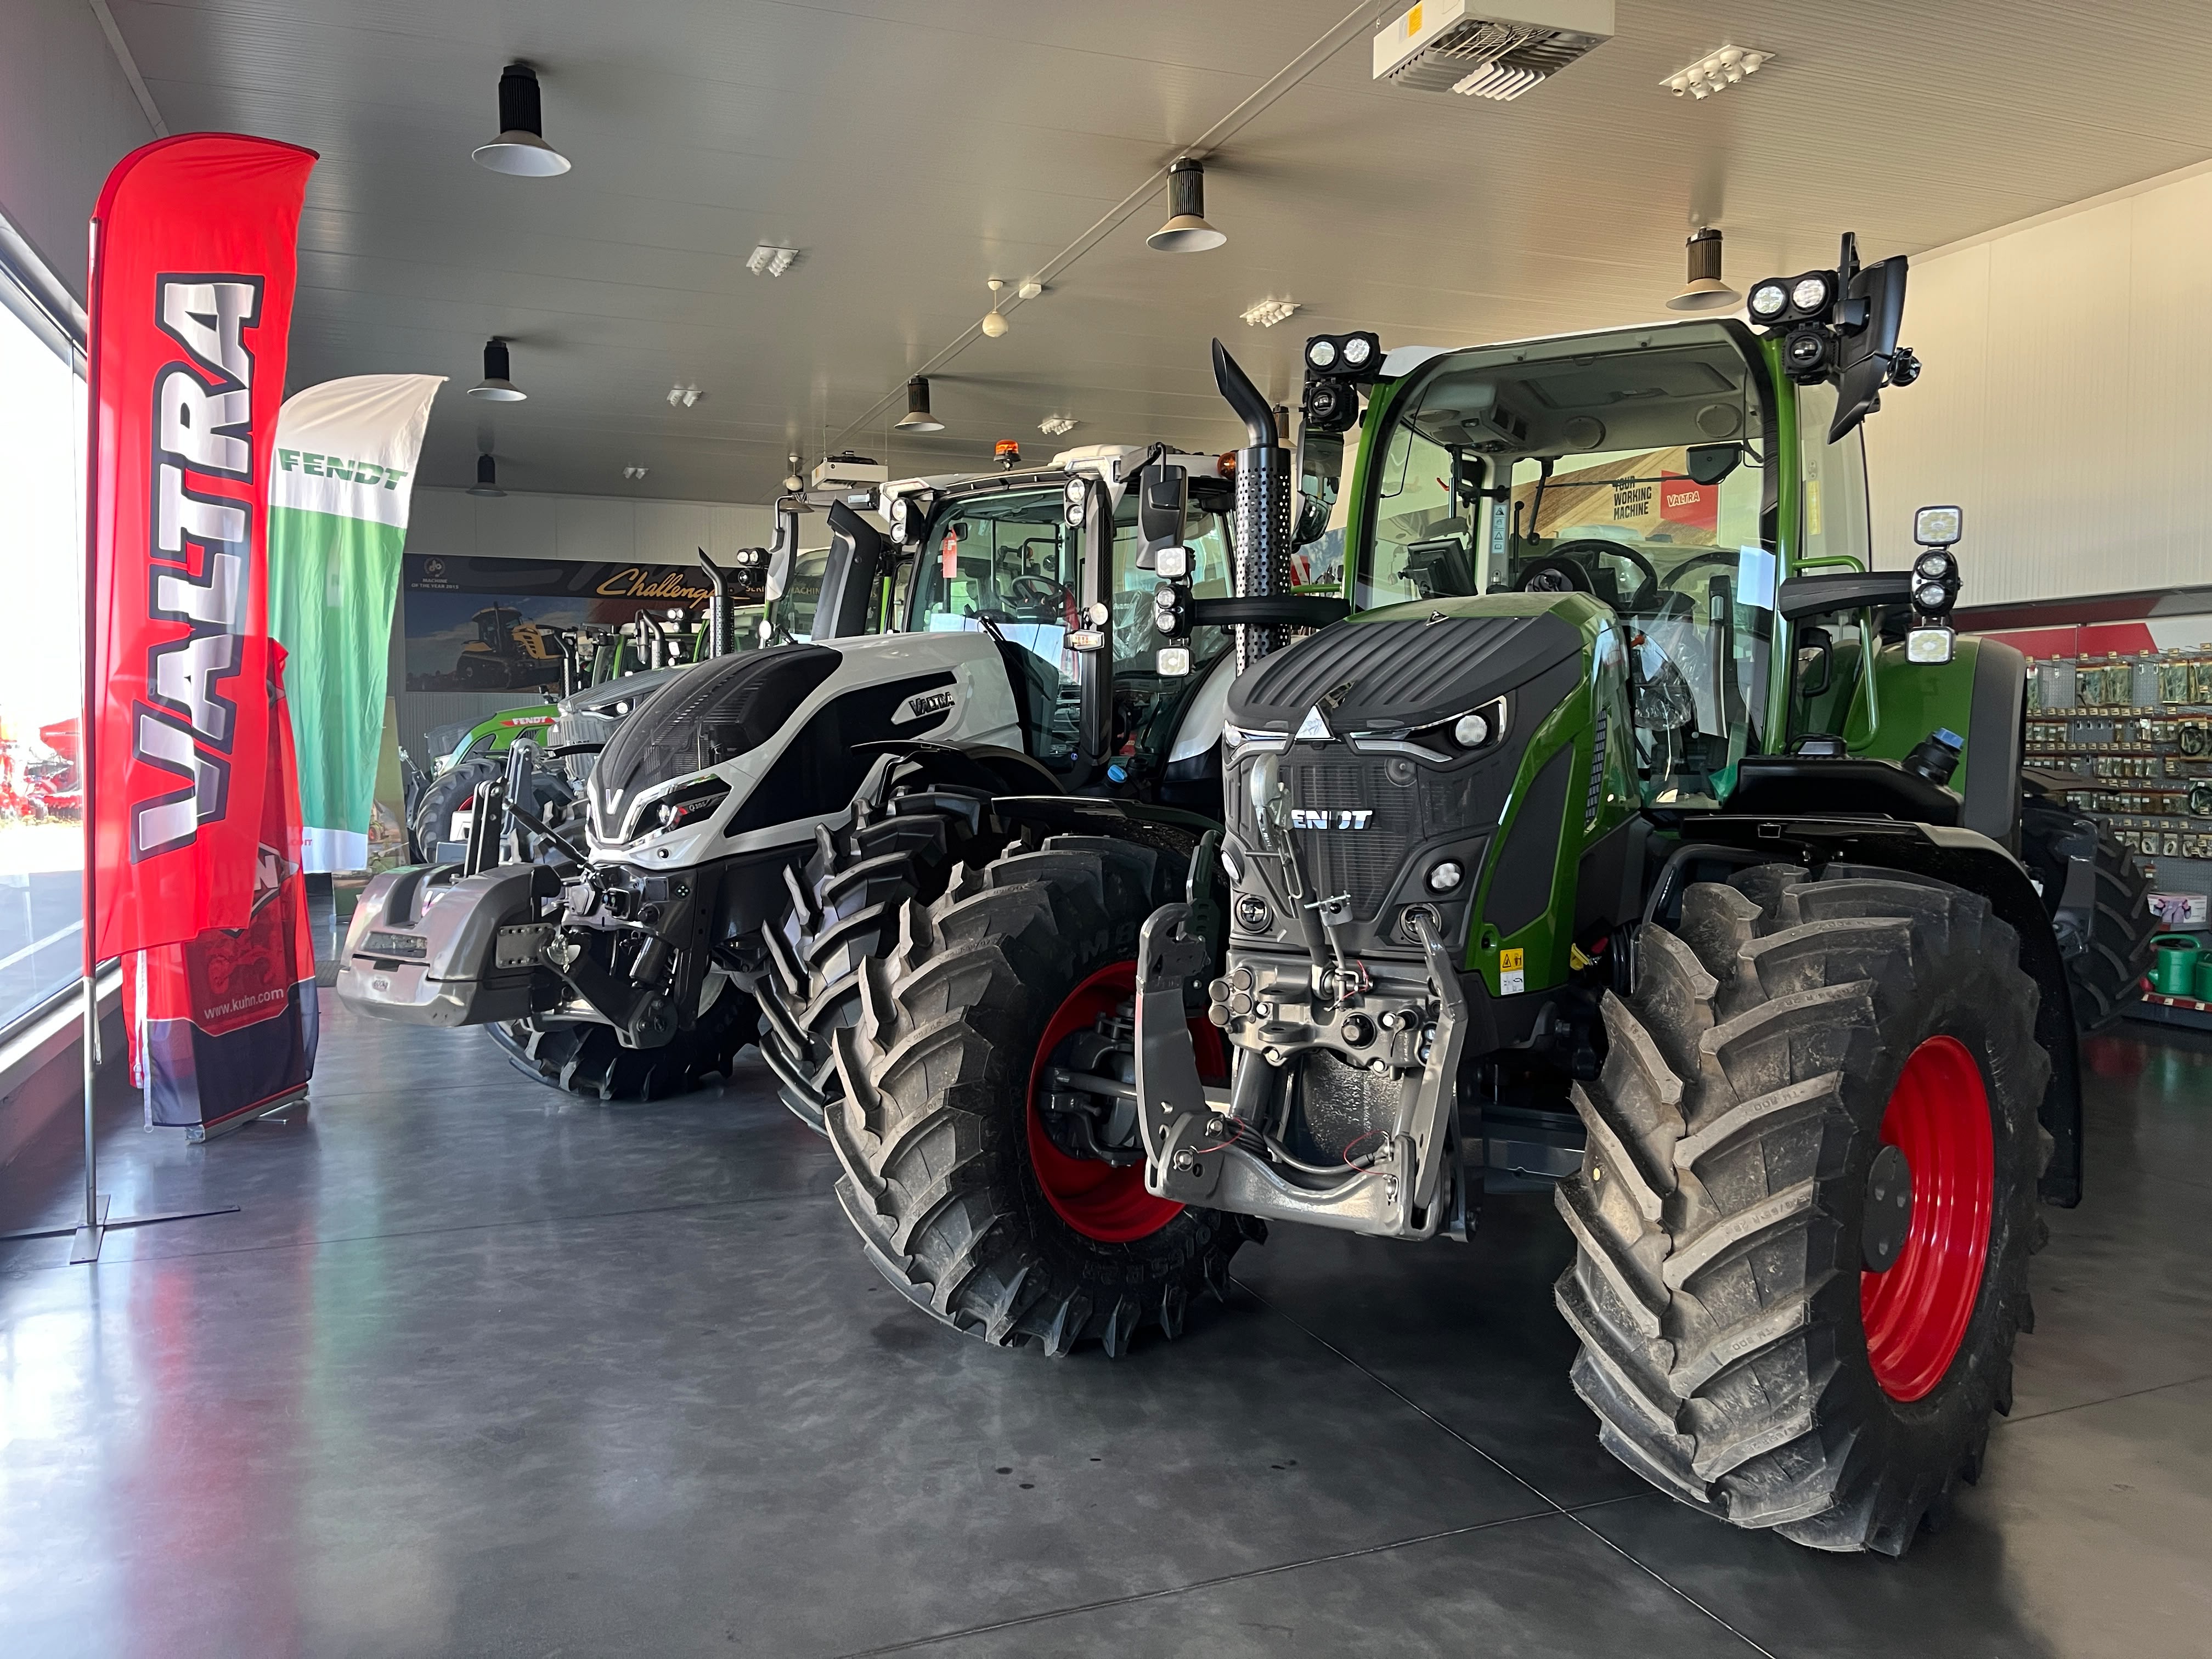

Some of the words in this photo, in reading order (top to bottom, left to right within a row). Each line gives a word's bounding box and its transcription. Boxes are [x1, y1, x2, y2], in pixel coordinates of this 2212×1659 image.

[278, 448, 408, 491] FENDT
[1614, 486, 1652, 506] WORKING
[1667, 491, 1700, 507] VALTRA
[1613, 501, 1649, 520] MACHINE
[131, 273, 264, 864] VALTRA
[596, 568, 717, 610] Challeng
[909, 691, 955, 716] VALTRA
[512, 716, 548, 725] FENDT
[1291, 809, 1373, 829] ENDT
[204, 988, 284, 1019] www.kuhn.com
